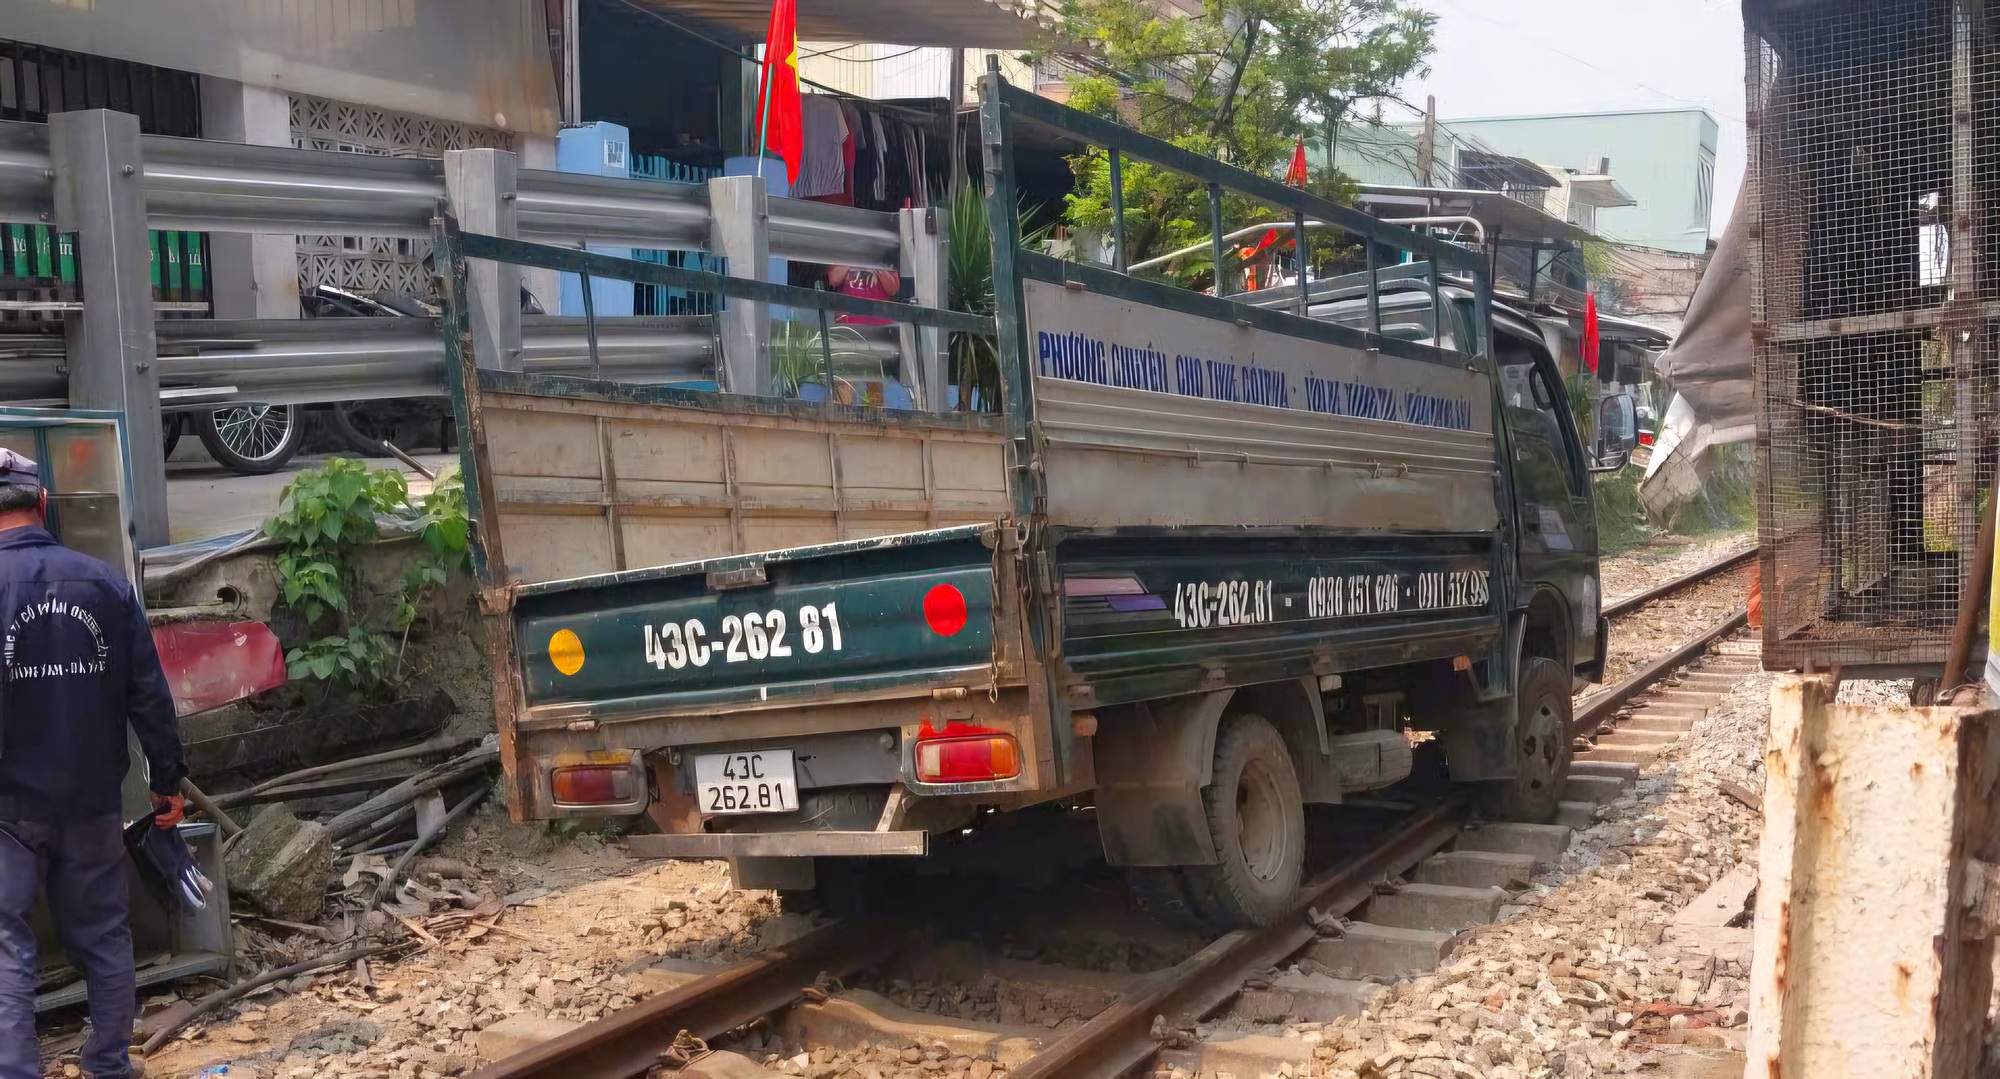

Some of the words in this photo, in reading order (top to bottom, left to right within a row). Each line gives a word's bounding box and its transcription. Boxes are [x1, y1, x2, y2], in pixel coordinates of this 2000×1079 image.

[1175, 580, 1273, 628] 43C-262.81
[723, 754, 765, 781] 43C
[708, 782, 785, 811] 262.81
